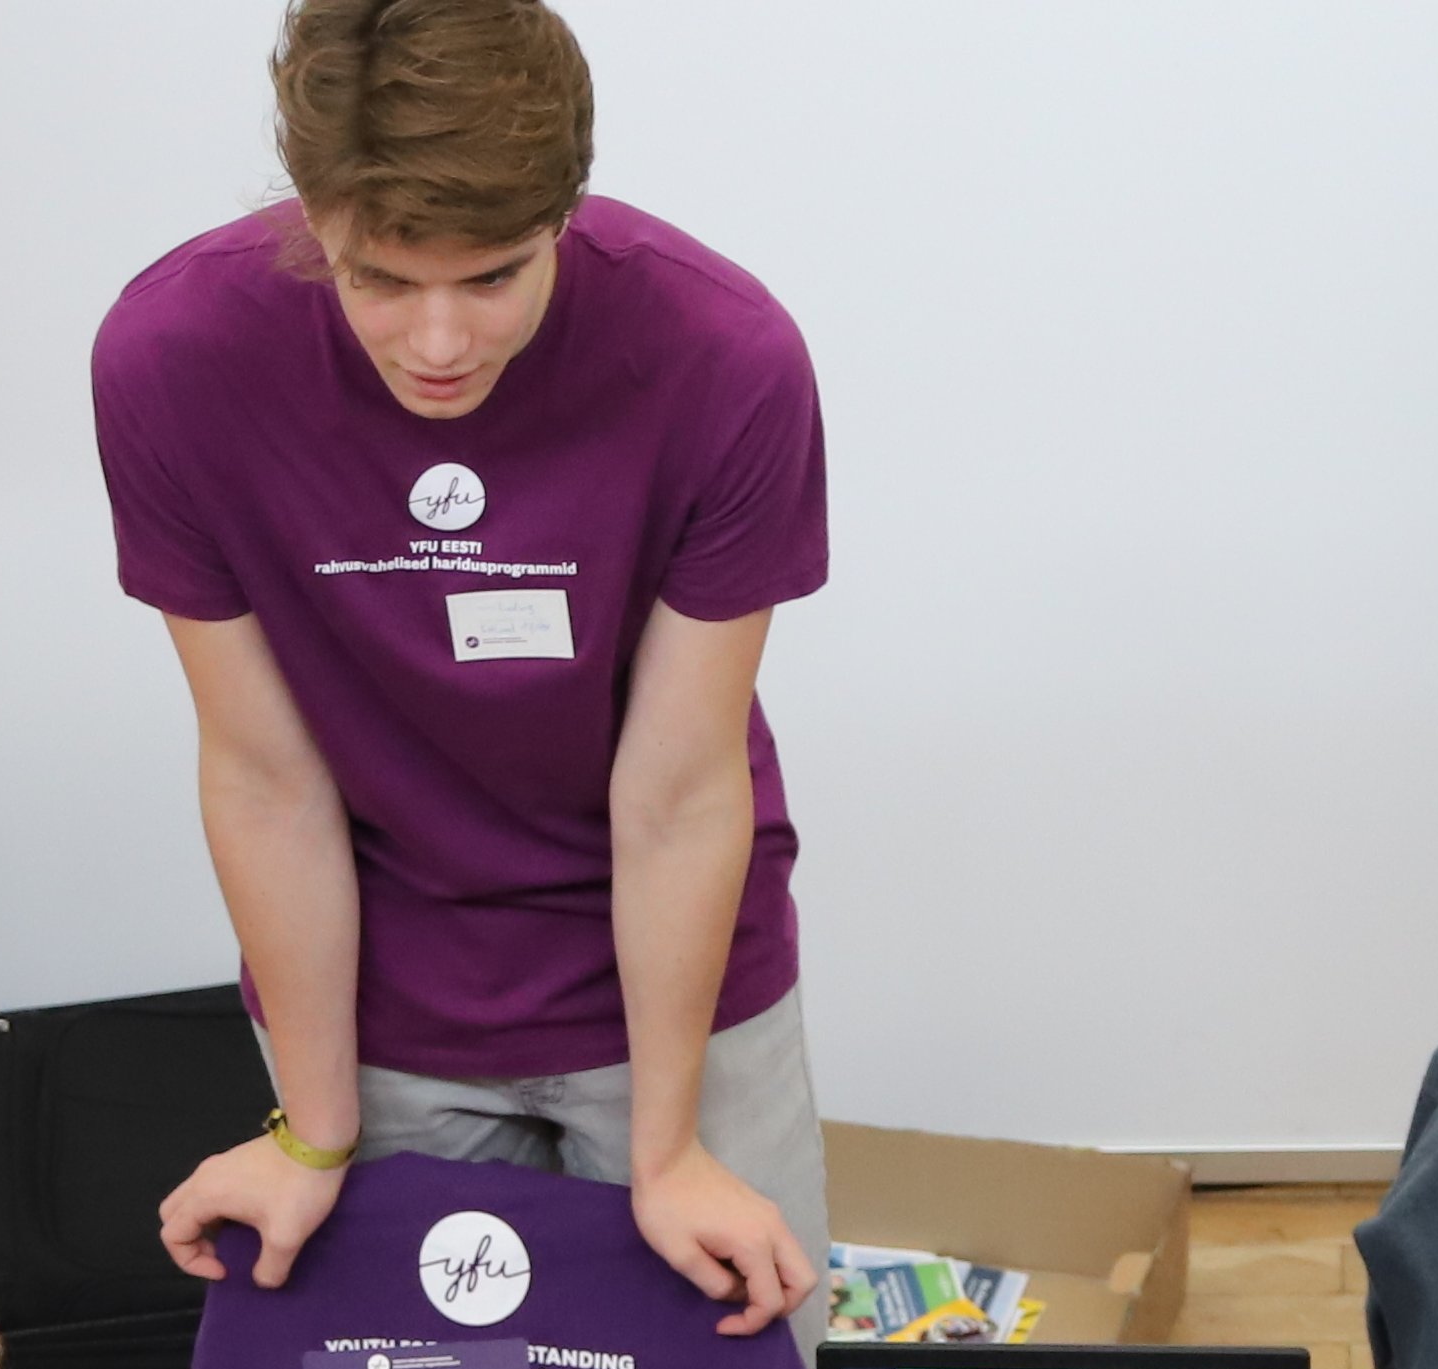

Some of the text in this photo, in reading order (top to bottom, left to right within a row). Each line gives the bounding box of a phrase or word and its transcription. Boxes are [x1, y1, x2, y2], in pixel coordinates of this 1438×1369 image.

[411, 476, 484, 520] yfu
[410, 540, 483, 555] YFU EESTI
[314, 556, 577, 578] rahvusvahelised haridusprogrammid
[420, 1235, 530, 1302] yfu
